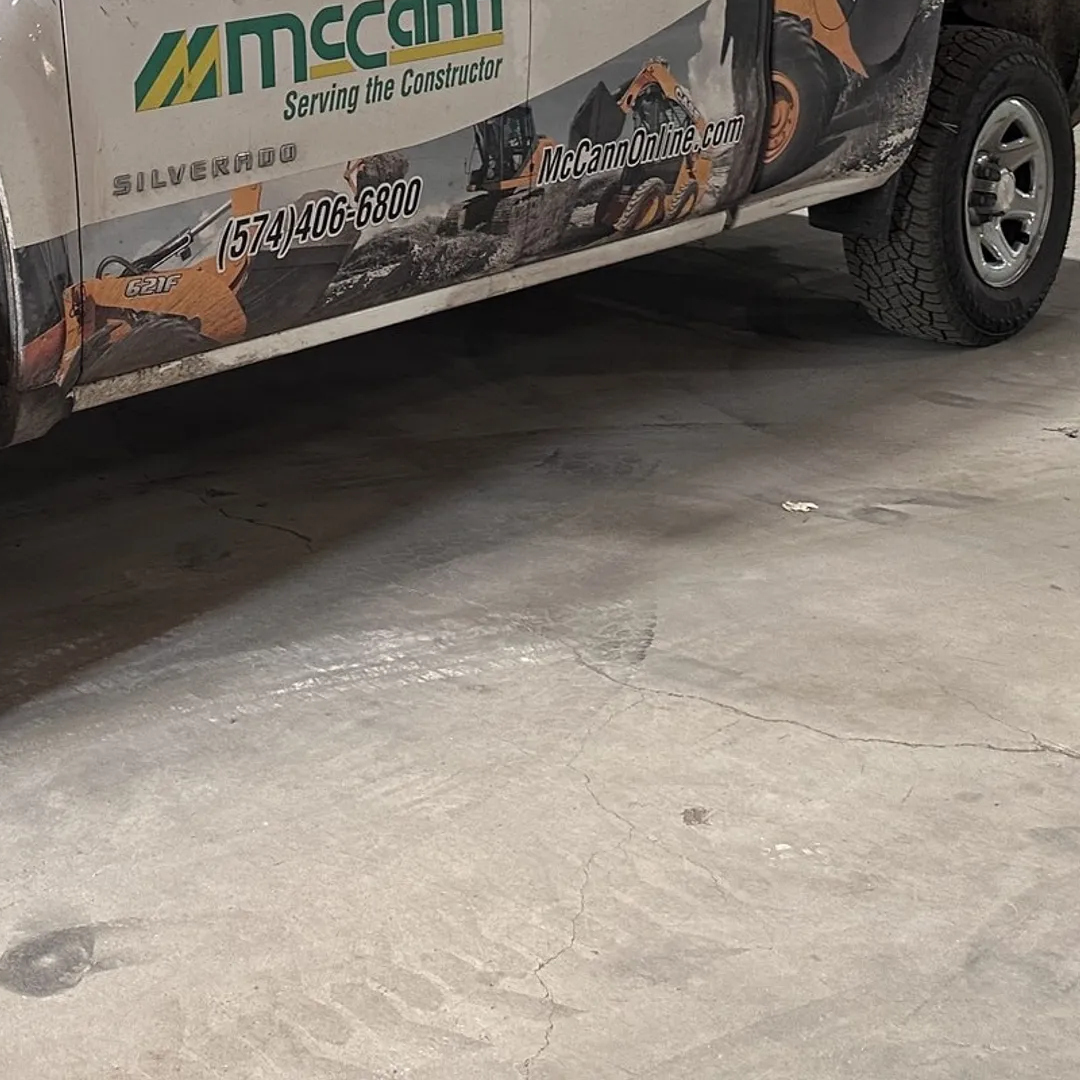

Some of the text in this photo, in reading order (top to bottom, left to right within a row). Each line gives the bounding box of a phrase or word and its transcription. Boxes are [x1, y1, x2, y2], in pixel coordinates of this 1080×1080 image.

[283, 56, 503, 121] Serving the Constructor
[112, 142, 298, 196] SILVERADO
[537, 115, 745, 186] McCannOnline.com
[217, 176, 422, 272] (574)406-6800
[124, 273, 182, 299] 621F
